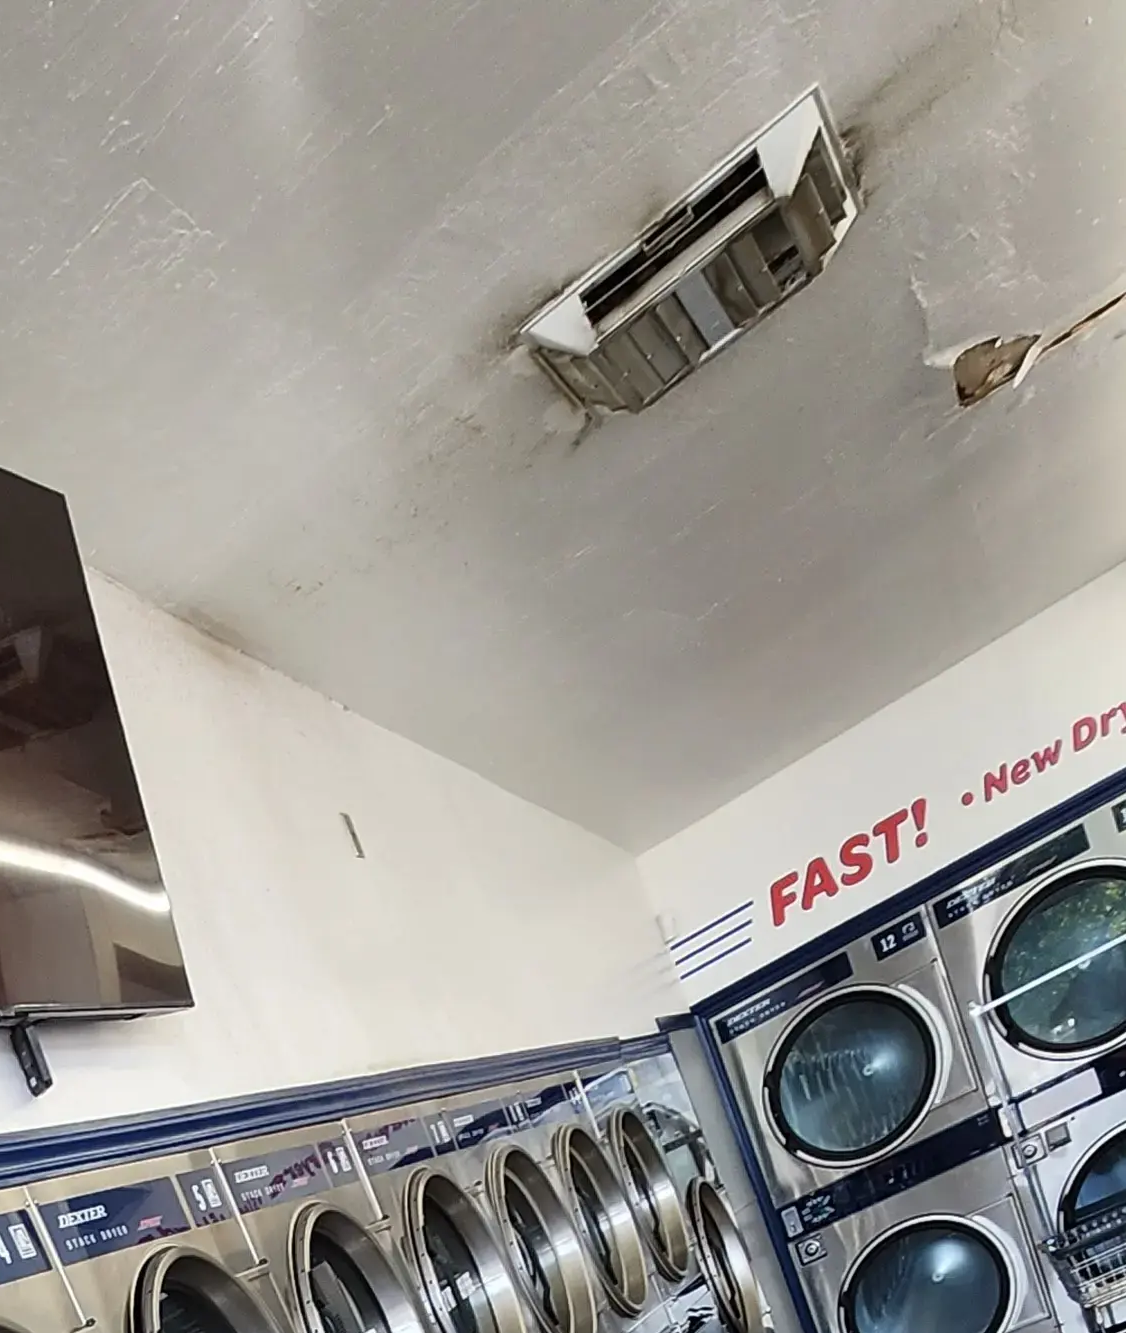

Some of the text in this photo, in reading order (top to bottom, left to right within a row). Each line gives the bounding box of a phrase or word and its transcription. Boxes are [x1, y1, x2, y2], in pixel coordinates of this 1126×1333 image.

[770, 798, 928, 927] FAST!
[983, 739, 1062, 802] New
[880, 933, 897, 952] 12
[57, 1204, 108, 1229] DEXTER
[65, 1225, 129, 1251] STACK DRYER
